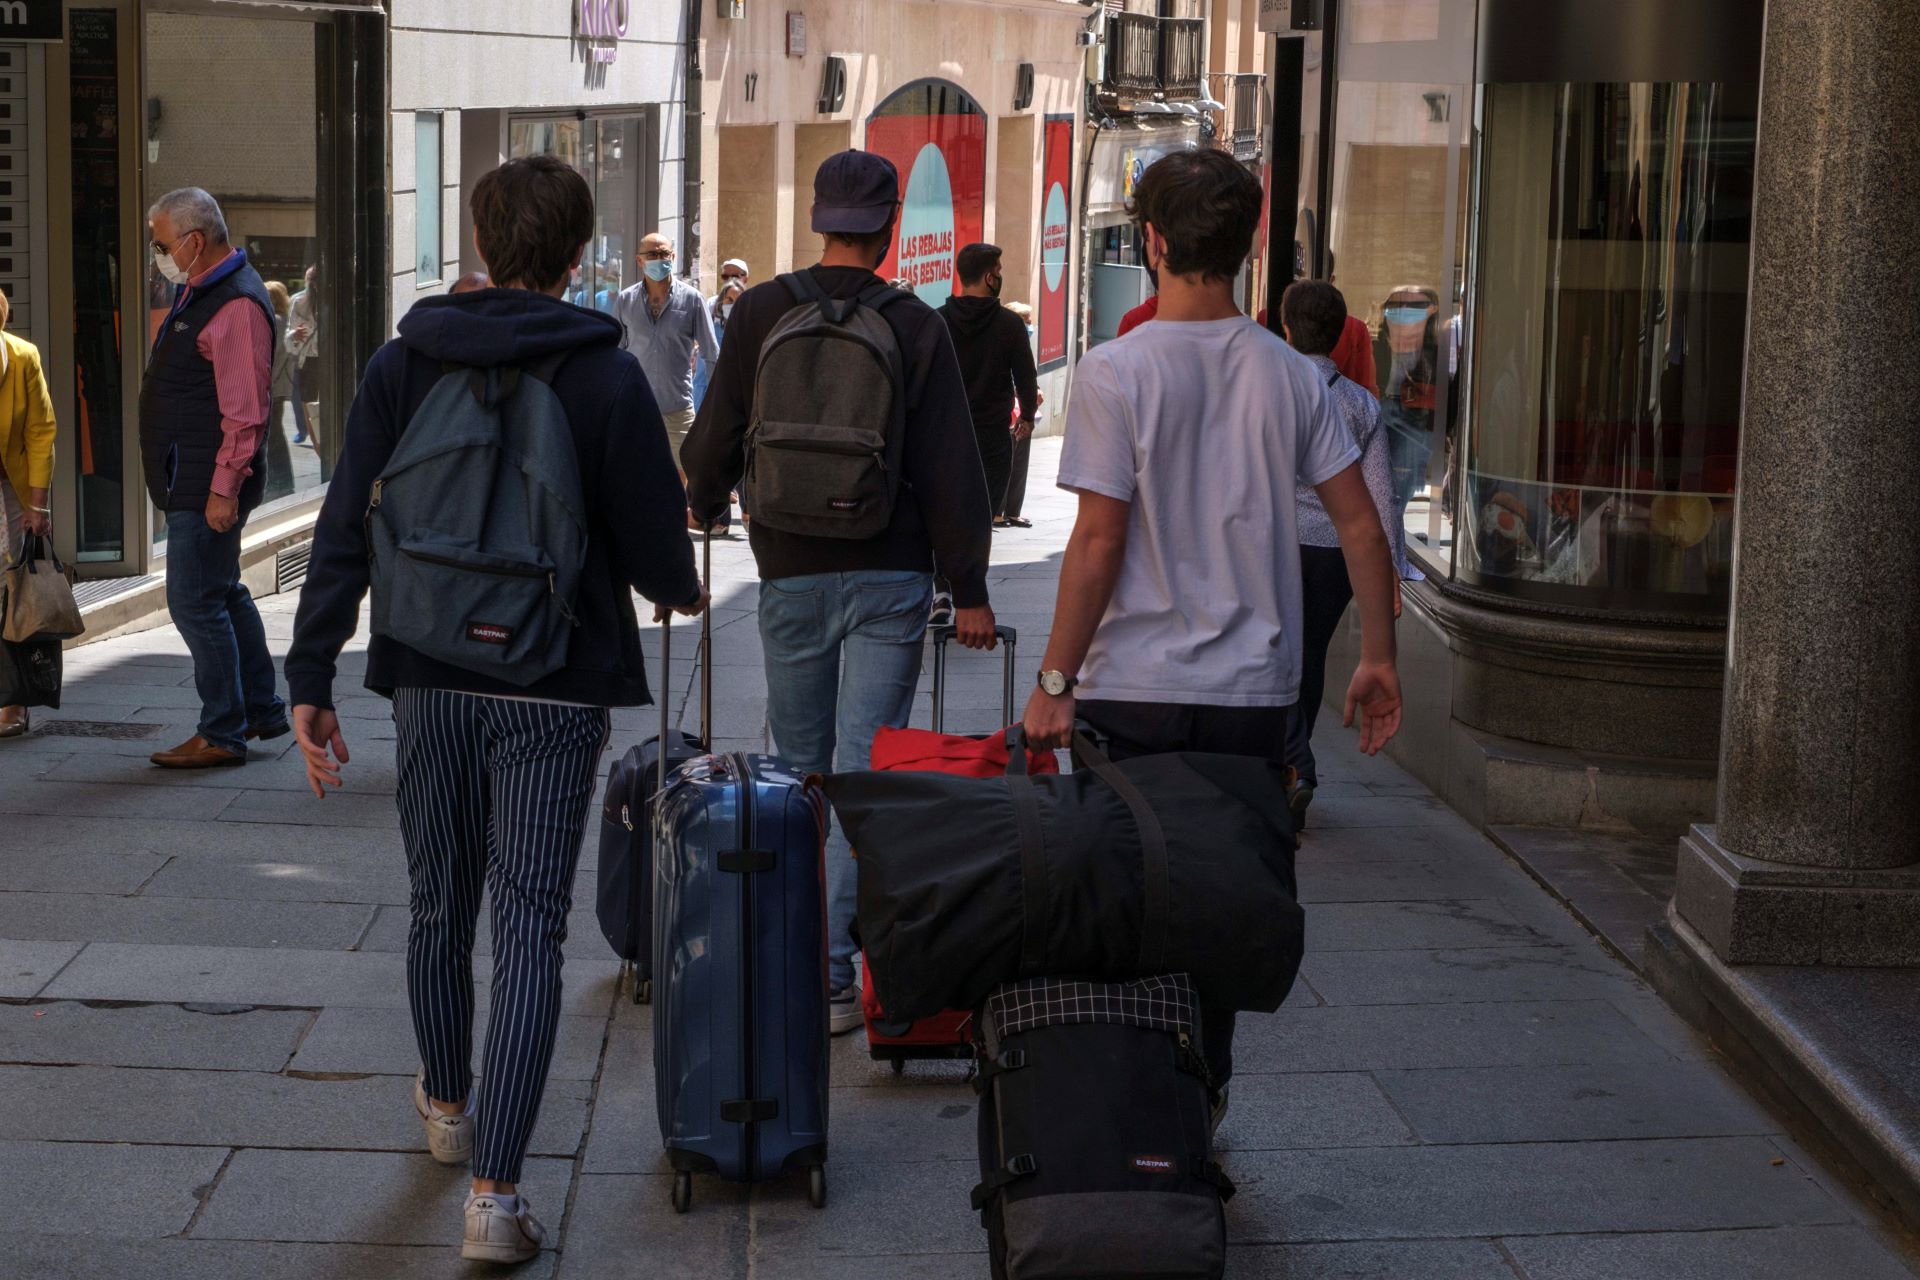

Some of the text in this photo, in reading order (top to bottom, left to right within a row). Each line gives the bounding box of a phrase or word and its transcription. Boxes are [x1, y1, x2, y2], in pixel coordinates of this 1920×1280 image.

[72, 85, 116, 98] AFFLE
[745, 73, 758, 102] 17
[901, 230, 952, 260] LAS REBAJAS
[900, 258, 951, 287] MÁS BESTIAS
[473, 628, 507, 639] EASTPAK
[1136, 1159, 1169, 1168] EASTPAK
